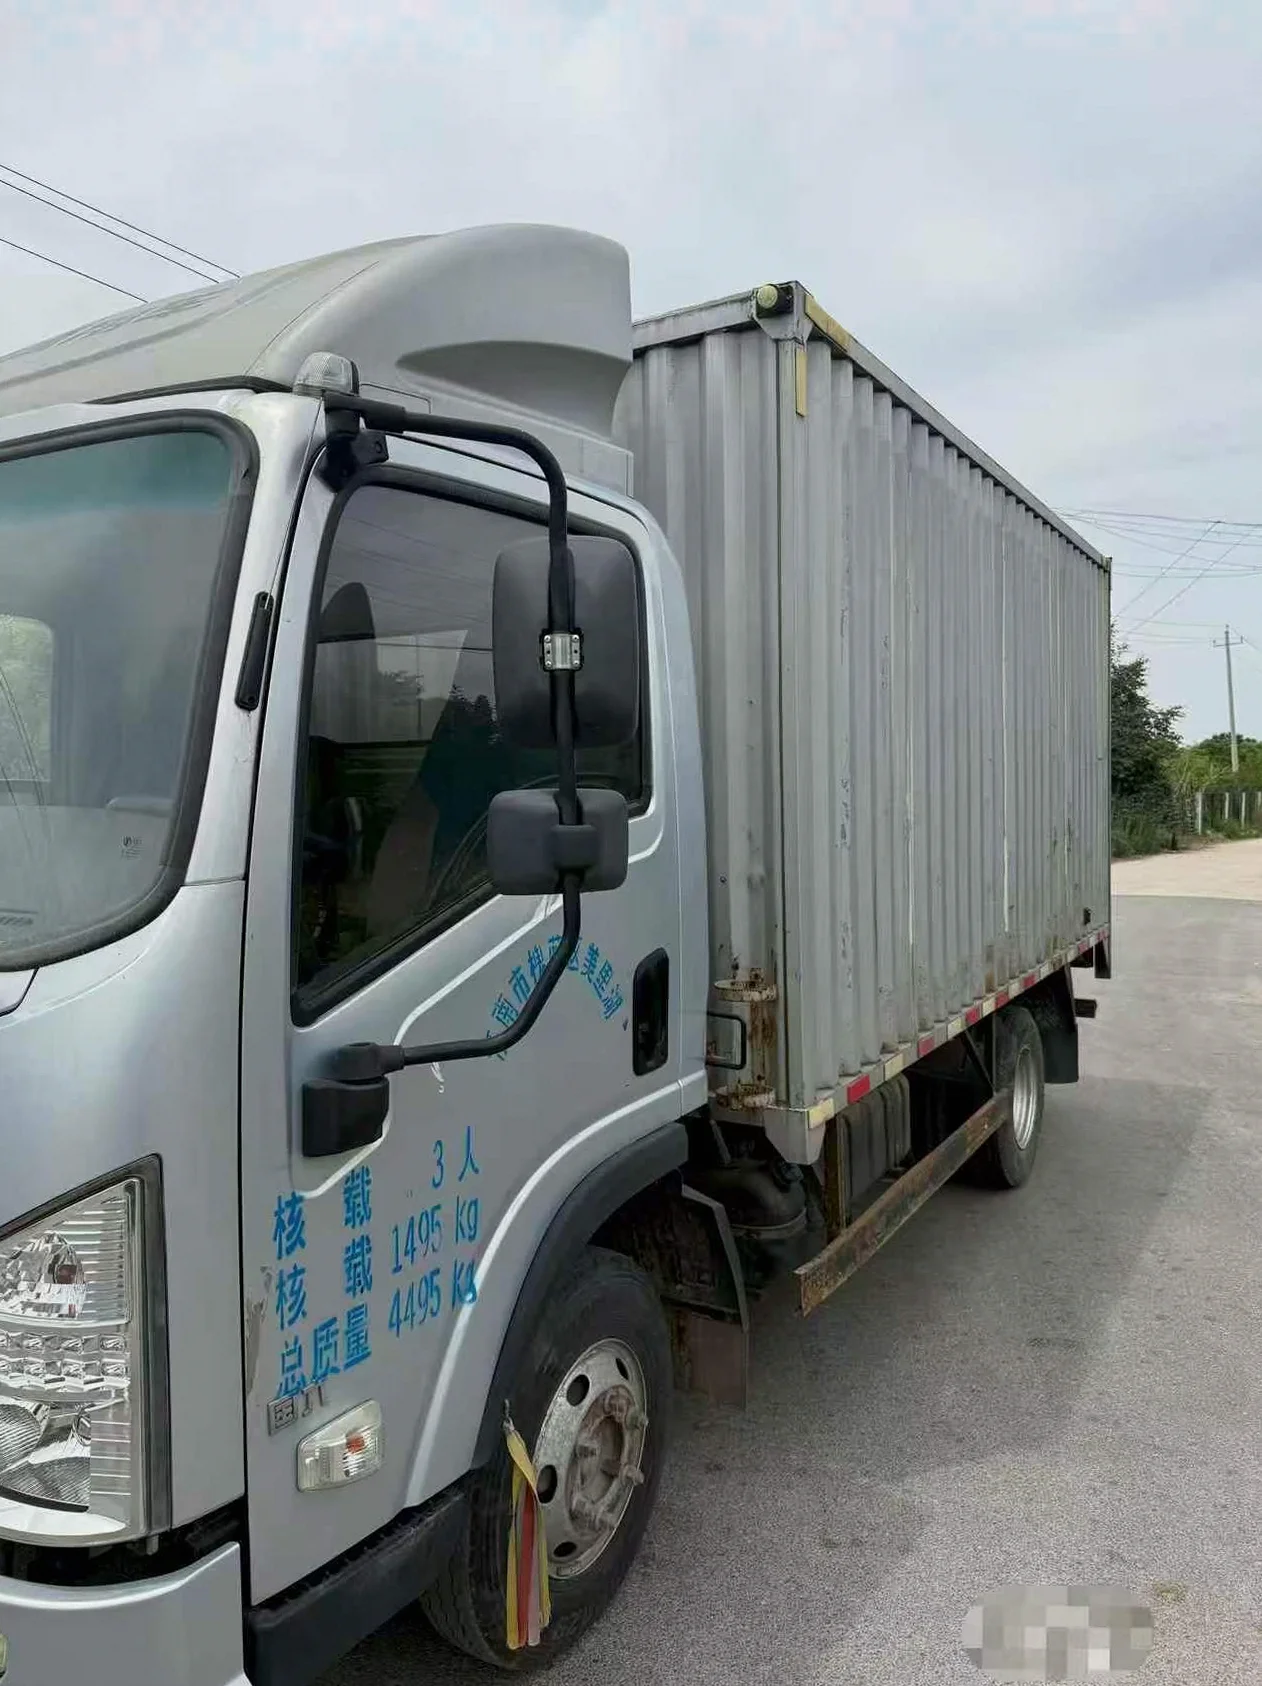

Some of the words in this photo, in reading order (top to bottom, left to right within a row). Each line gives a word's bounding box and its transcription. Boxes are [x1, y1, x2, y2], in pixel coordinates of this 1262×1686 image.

[391, 1204, 442, 1275] 1495
[275, 1302, 372, 1400] 总质量
[387, 1267, 442, 1337] 4495
